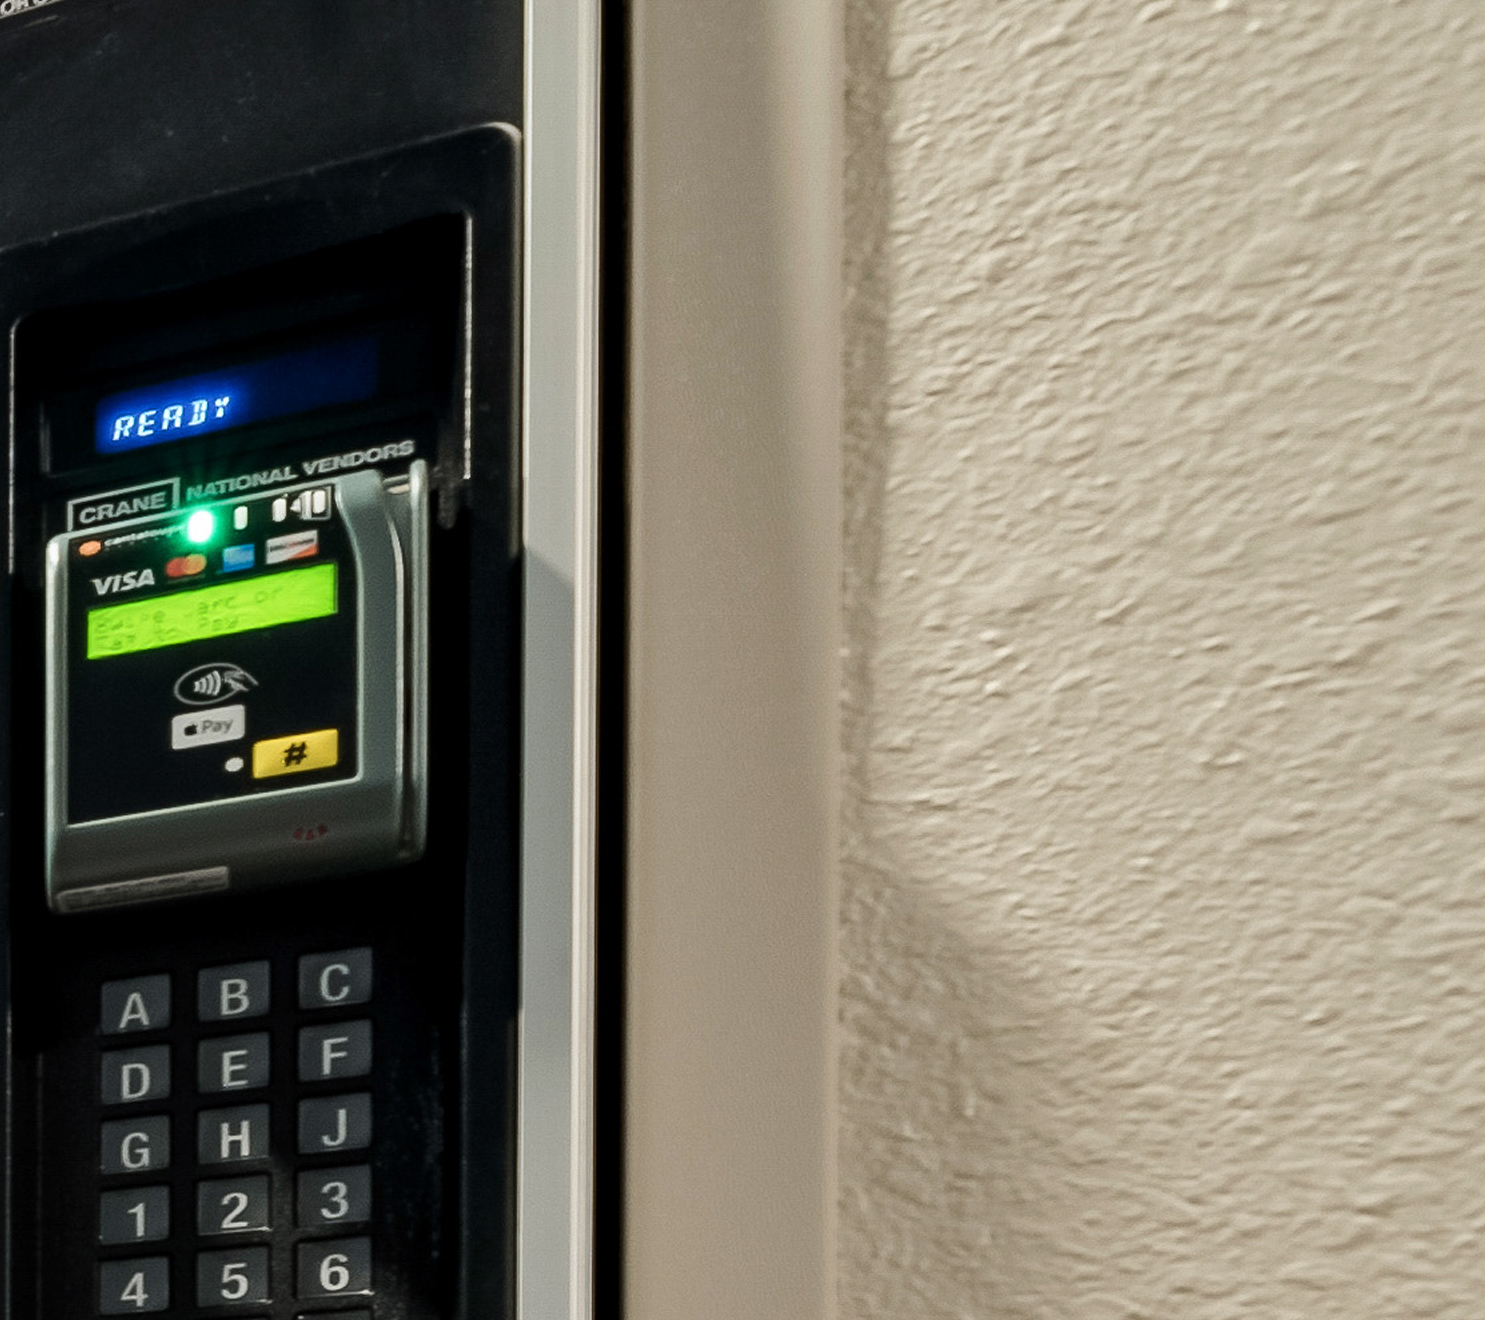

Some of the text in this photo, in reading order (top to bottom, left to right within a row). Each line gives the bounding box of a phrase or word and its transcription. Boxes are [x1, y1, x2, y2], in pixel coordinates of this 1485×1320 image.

[112, 396, 231, 442] READY
[79, 439, 416, 525] CRANE NATIONAL VENDORS
[92, 568, 155, 596] VISA
[202, 717, 234, 737] Pay
[119, 964, 350, 1030] A B C
[122, 1037, 348, 1101] D E F
[121, 1108, 347, 1169] G H J
[127, 1181, 349, 1238] 1 2 3
[121, 1254, 350, 1307] 4 5 6
